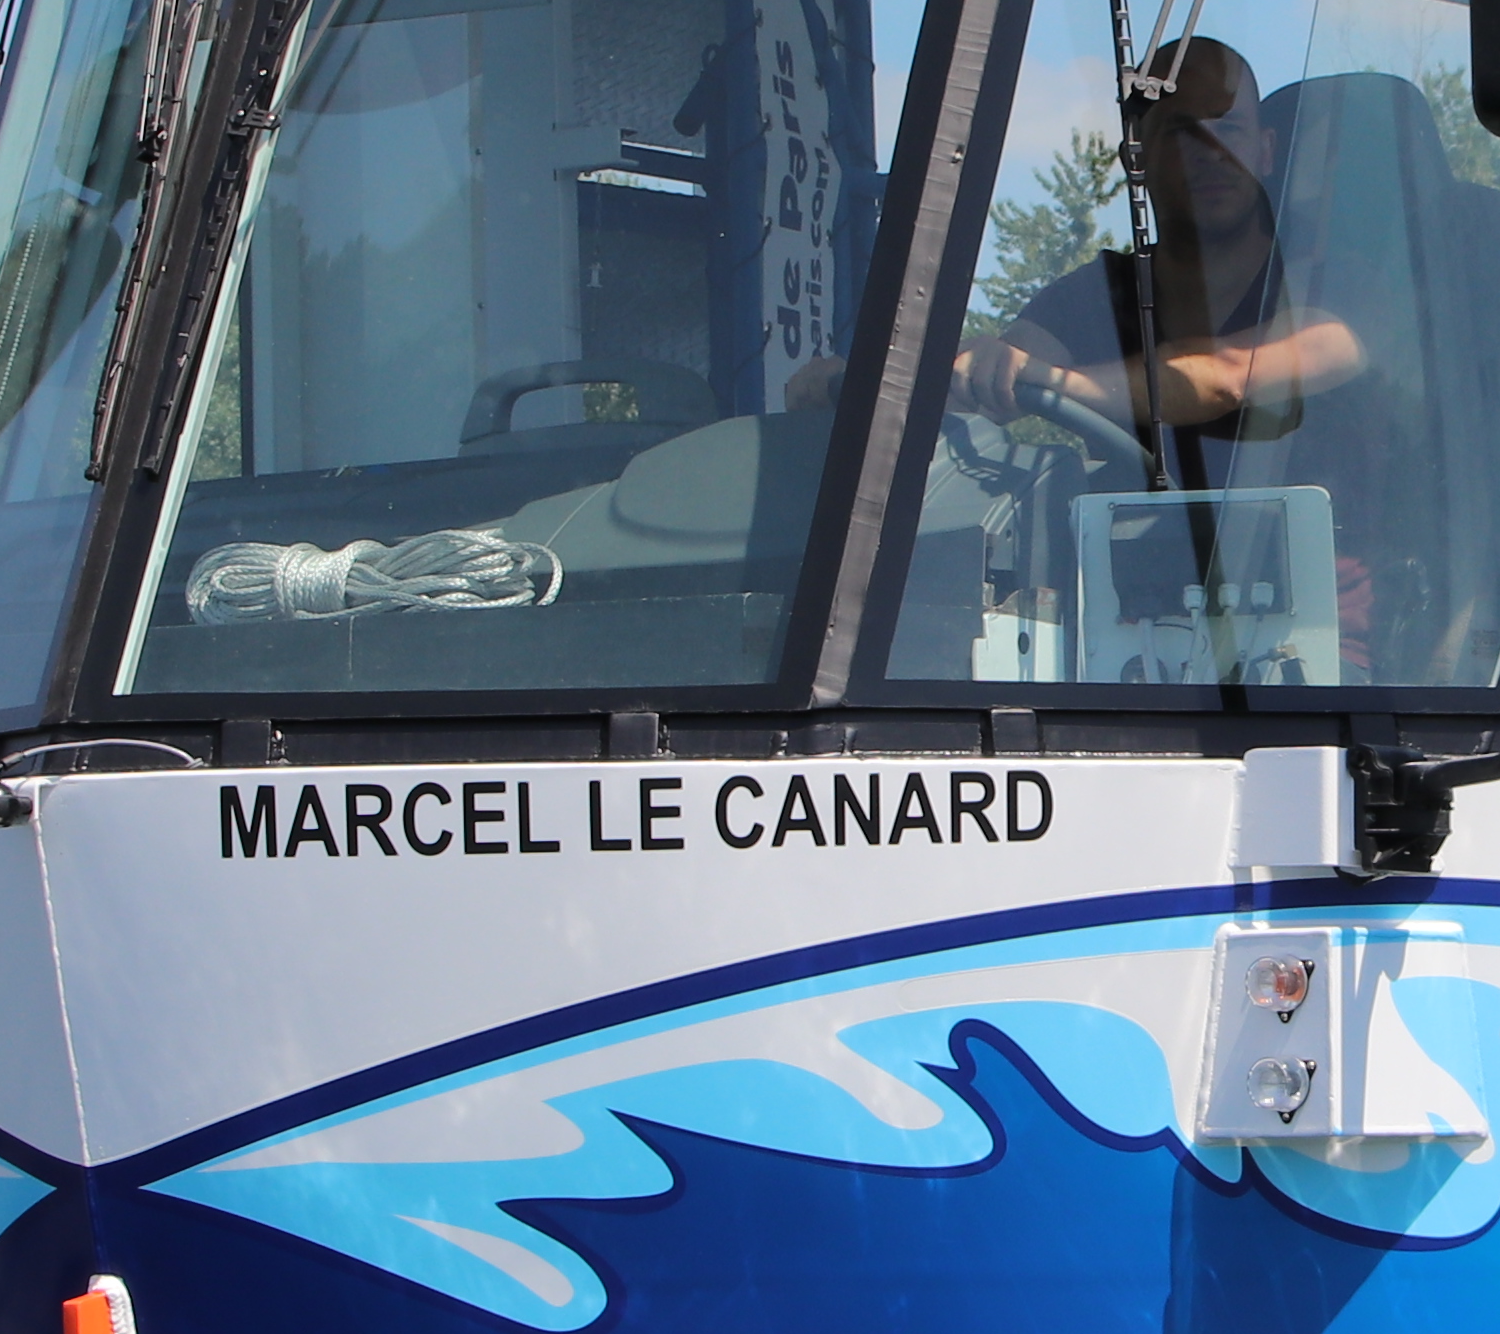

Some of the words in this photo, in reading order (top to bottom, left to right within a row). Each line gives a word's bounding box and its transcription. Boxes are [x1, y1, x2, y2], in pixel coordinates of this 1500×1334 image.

[773, 40, 808, 231] Paris
[777, 257, 802, 359] de
[220, 781, 561, 858] MARCEL
[589, 777, 685, 851] LE
[715, 770, 1054, 849] CANARD
